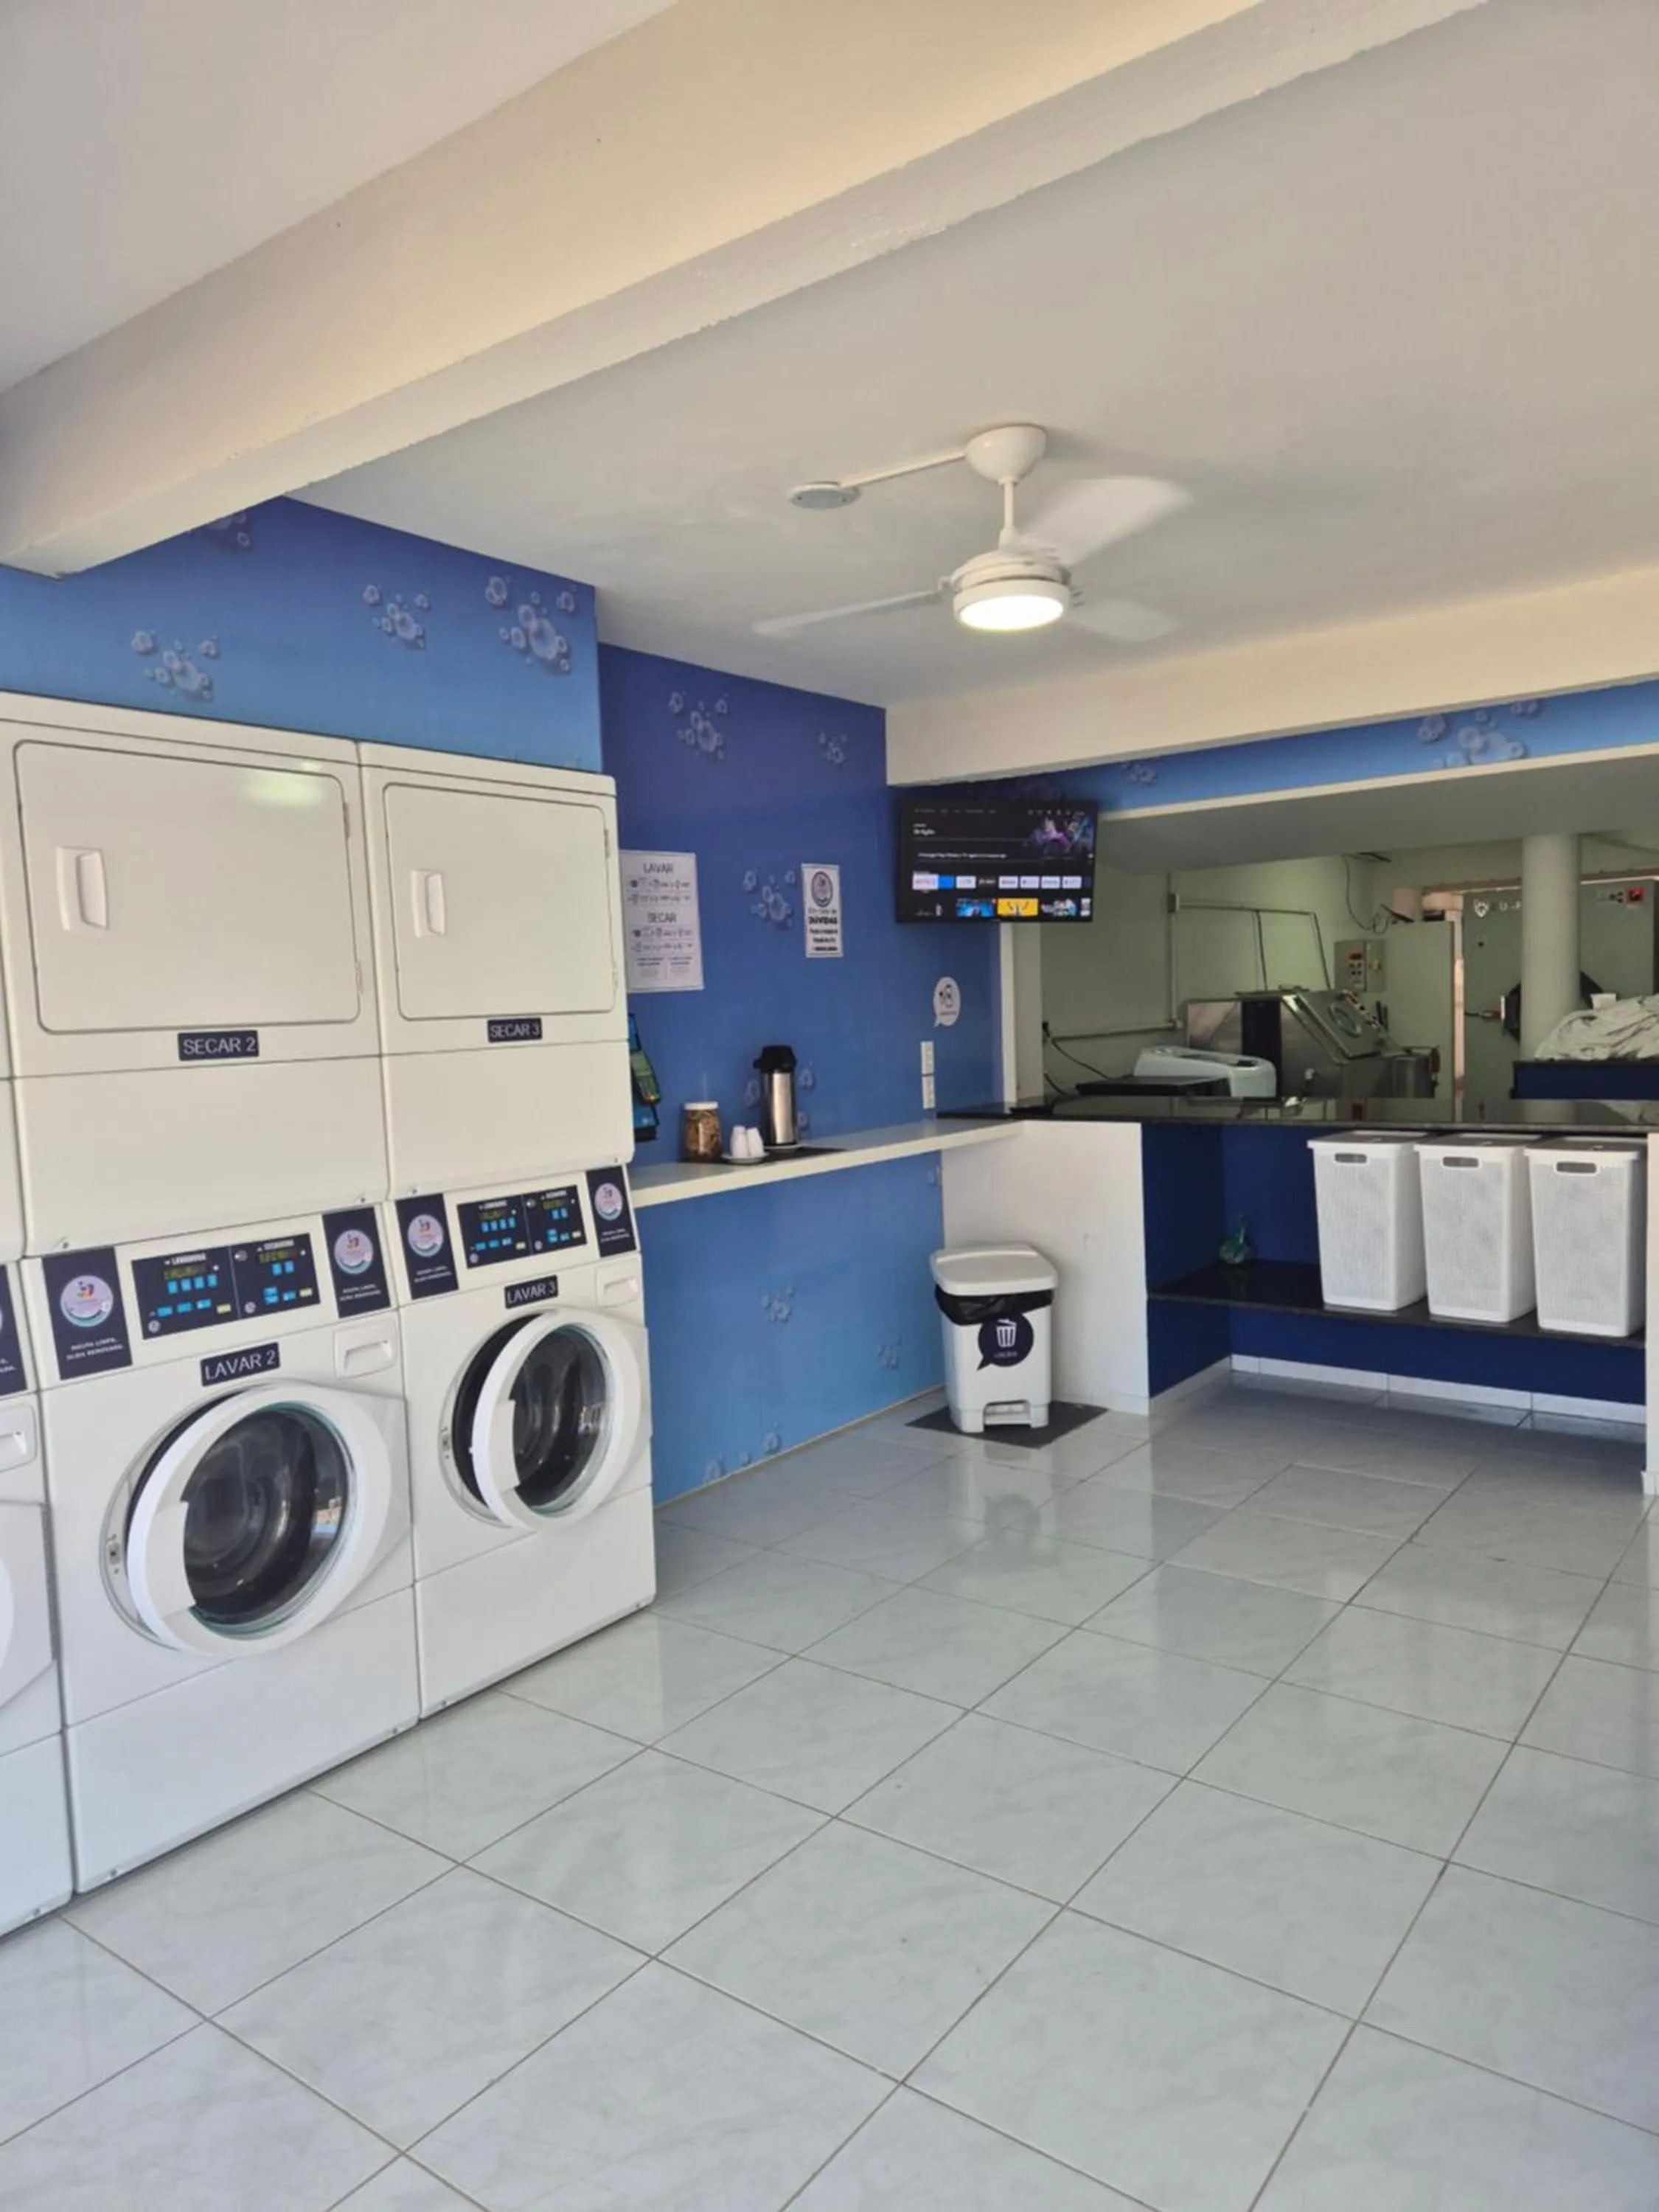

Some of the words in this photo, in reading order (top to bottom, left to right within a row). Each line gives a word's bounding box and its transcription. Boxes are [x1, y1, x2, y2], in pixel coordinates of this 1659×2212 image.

[643, 862, 674, 874] LAVAR
[647, 911, 677, 924] SECAR
[489, 1023, 531, 1038] SECAR
[532, 1022, 540, 1035] 3
[183, 1036, 241, 1055] SECAR
[246, 1036, 256, 1052] 2
[507, 1283, 546, 1304] LAVAR
[548, 1281, 556, 1295] 3
[205, 1353, 262, 1380] LAVAR
[266, 1349, 276, 1366] 2
